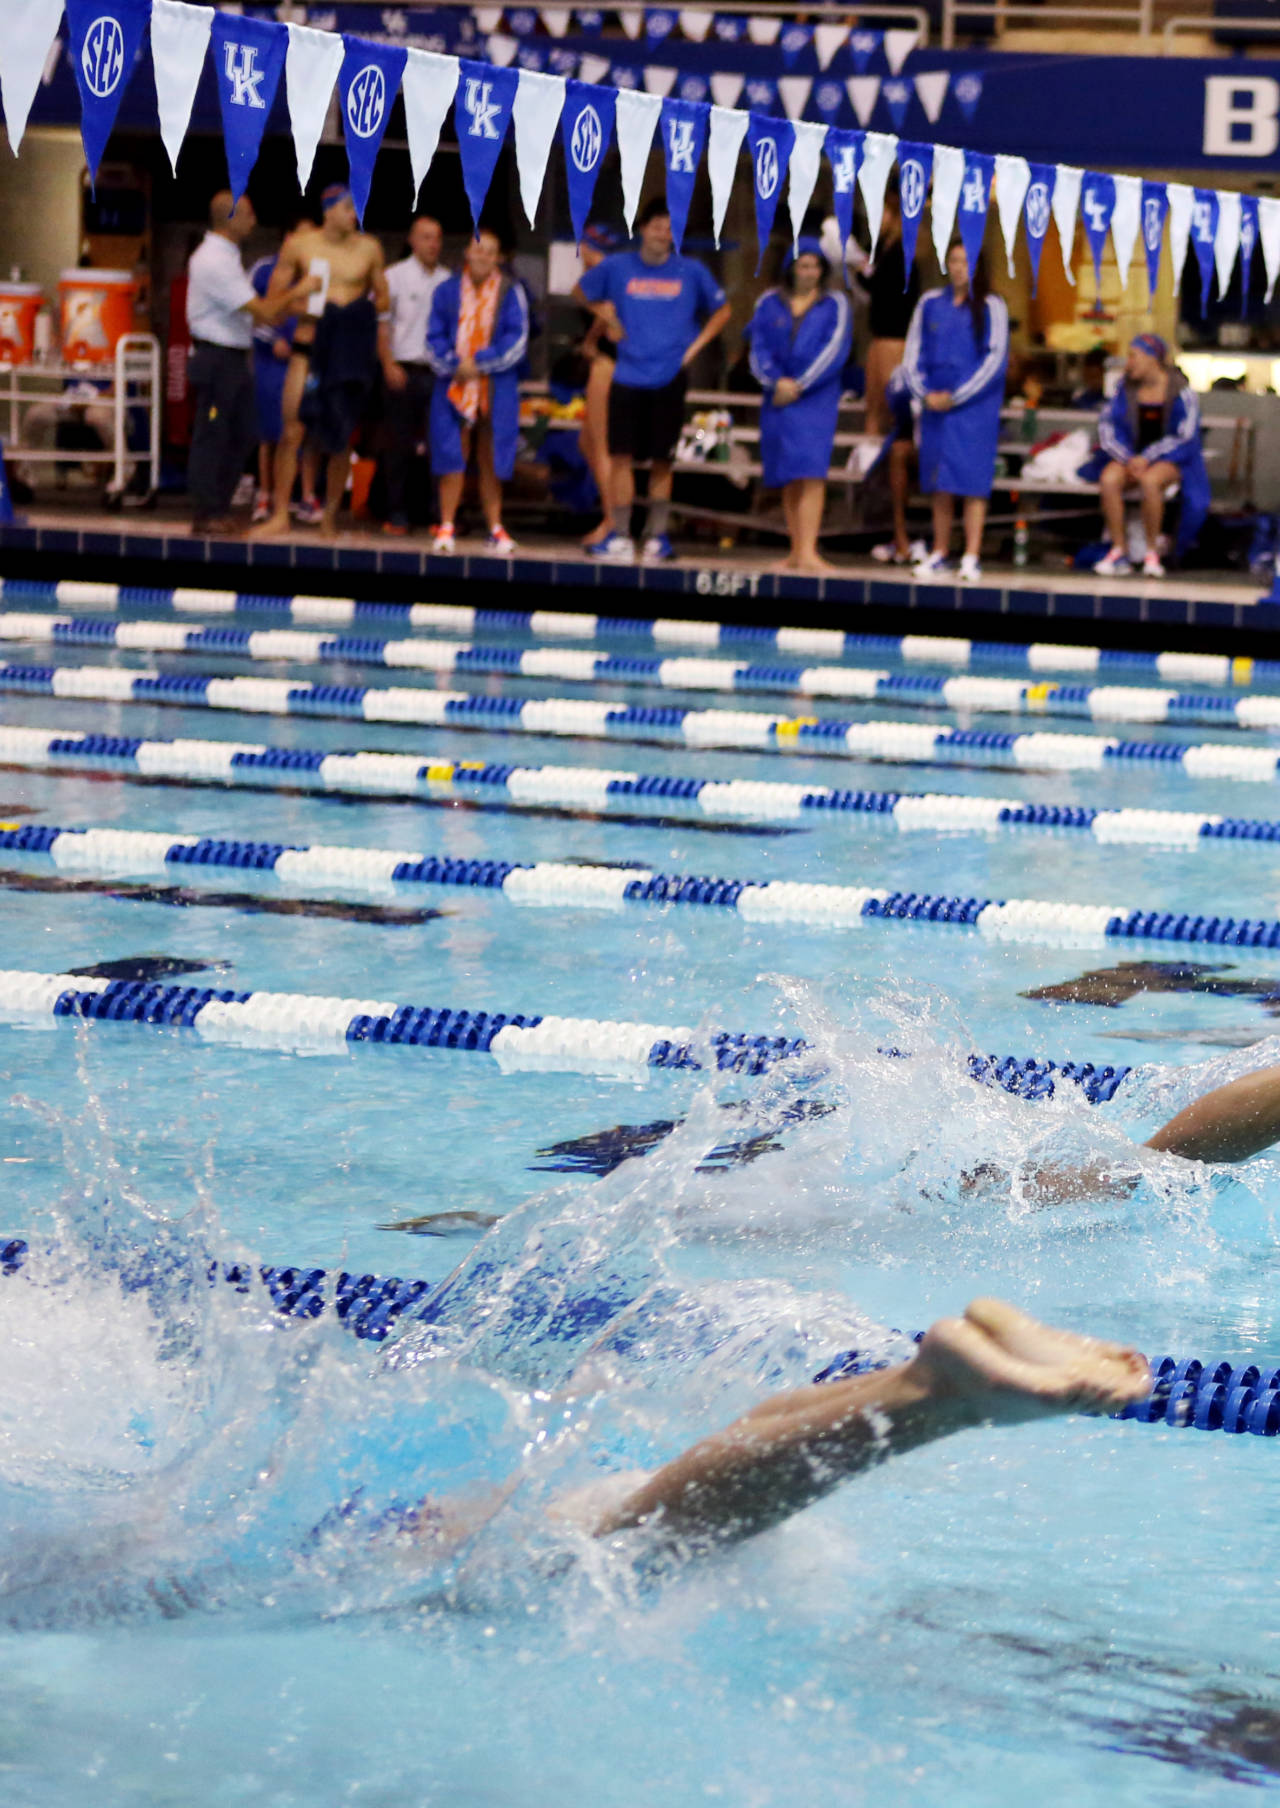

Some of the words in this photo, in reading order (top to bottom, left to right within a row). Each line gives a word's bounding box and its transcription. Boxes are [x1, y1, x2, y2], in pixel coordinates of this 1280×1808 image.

[82, 16, 124, 97] SEC
[224, 41, 265, 109] UK
[347, 64, 385, 138] SEC
[465, 77, 502, 140] UK
[668, 118, 696, 173] UK
